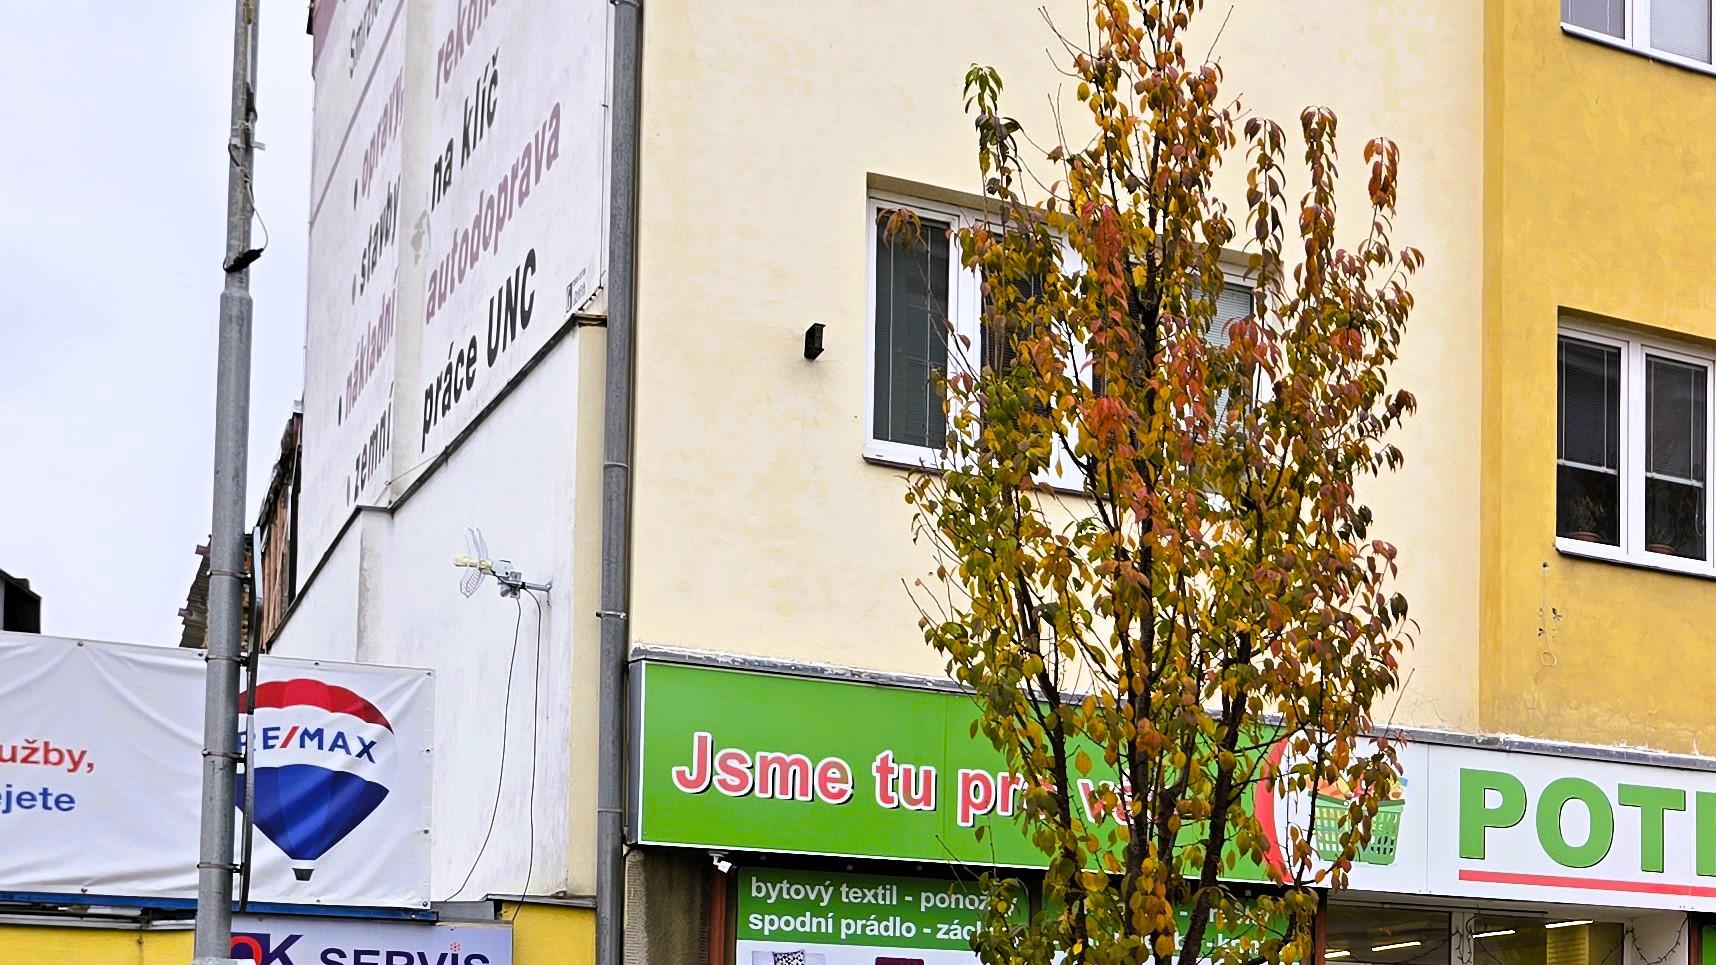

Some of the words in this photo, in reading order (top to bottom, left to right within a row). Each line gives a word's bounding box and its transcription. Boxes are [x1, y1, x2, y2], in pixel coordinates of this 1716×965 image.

[435, 0, 498, 100] rekon
[360, 173, 400, 297] stavby
[431, 137, 454, 213] na
[460, 46, 500, 170] klíč
[426, 102, 561, 325] autodoprava
[353, 381, 394, 503] zemní
[420, 334, 477, 453] práce
[486, 248, 537, 368] UNC
[0, 784, 76, 814] jete
[672, 732, 853, 804] Jsme
[872, 749, 938, 811] tu
[749, 912, 833, 935] spodní
[840, 915, 916, 938] prádlo
[751, 876, 834, 906] bytový
[840, 882, 897, 905] textil
[920, 889, 1018, 917] ponožy
